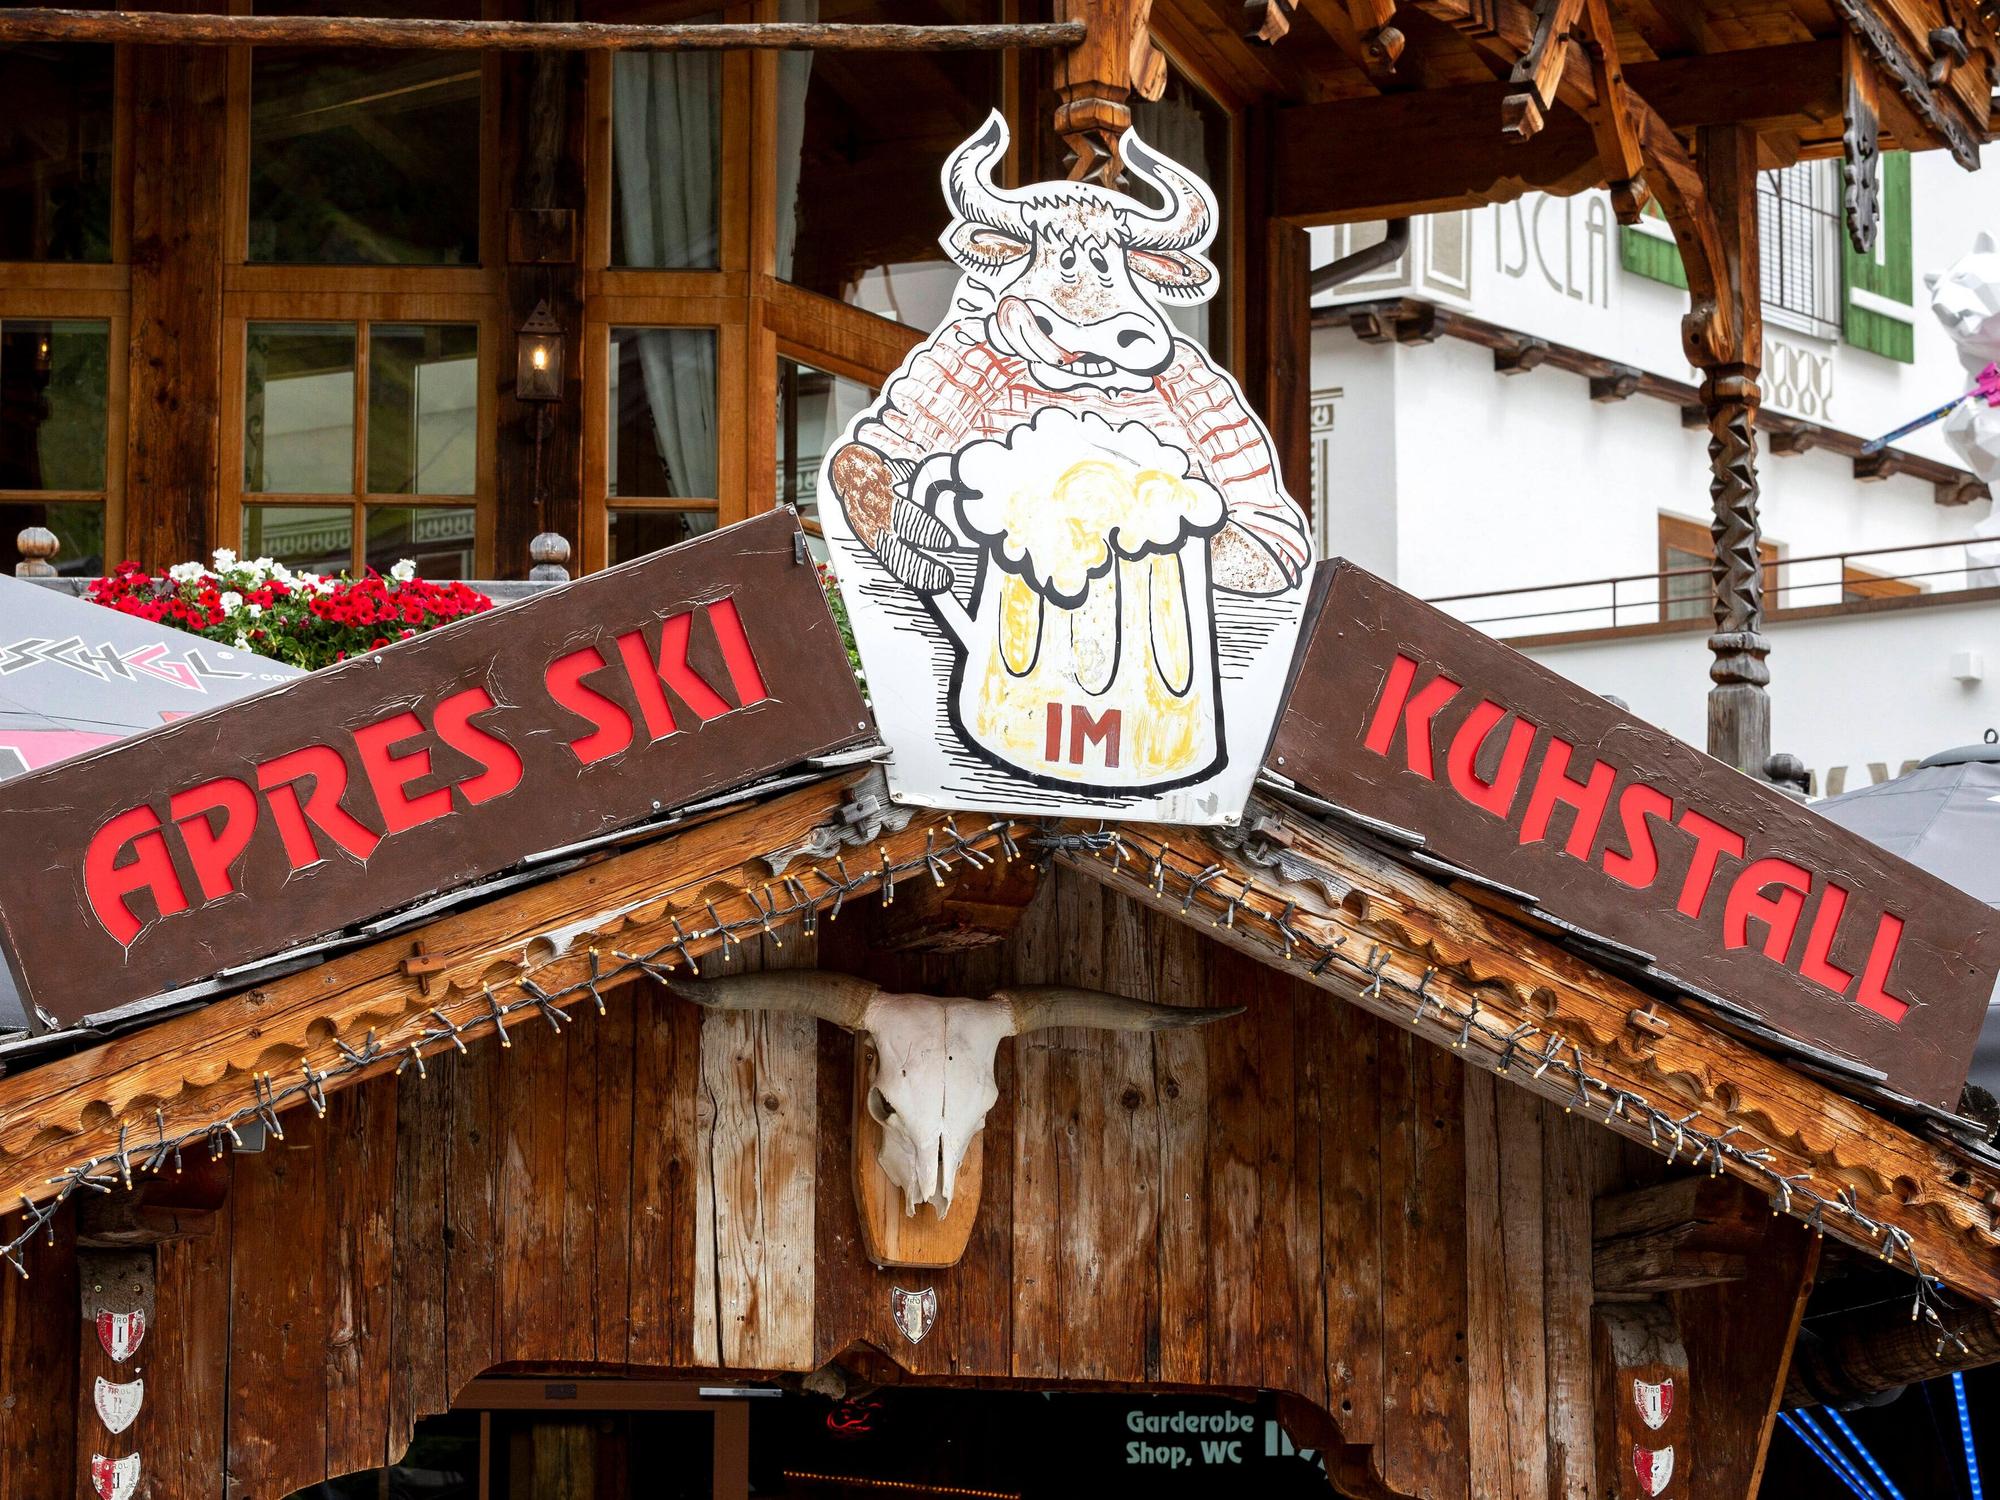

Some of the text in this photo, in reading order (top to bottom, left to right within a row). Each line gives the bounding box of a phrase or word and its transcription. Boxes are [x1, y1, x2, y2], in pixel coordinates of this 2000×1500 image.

[1045, 702, 1122, 769] IM
[84, 596, 769, 948] APRES SKI
[1364, 652, 1911, 1025] KUHSTALL
[1126, 1410, 1255, 1433] Garderobe
[1126, 1441, 1242, 1469] Shop, WC
